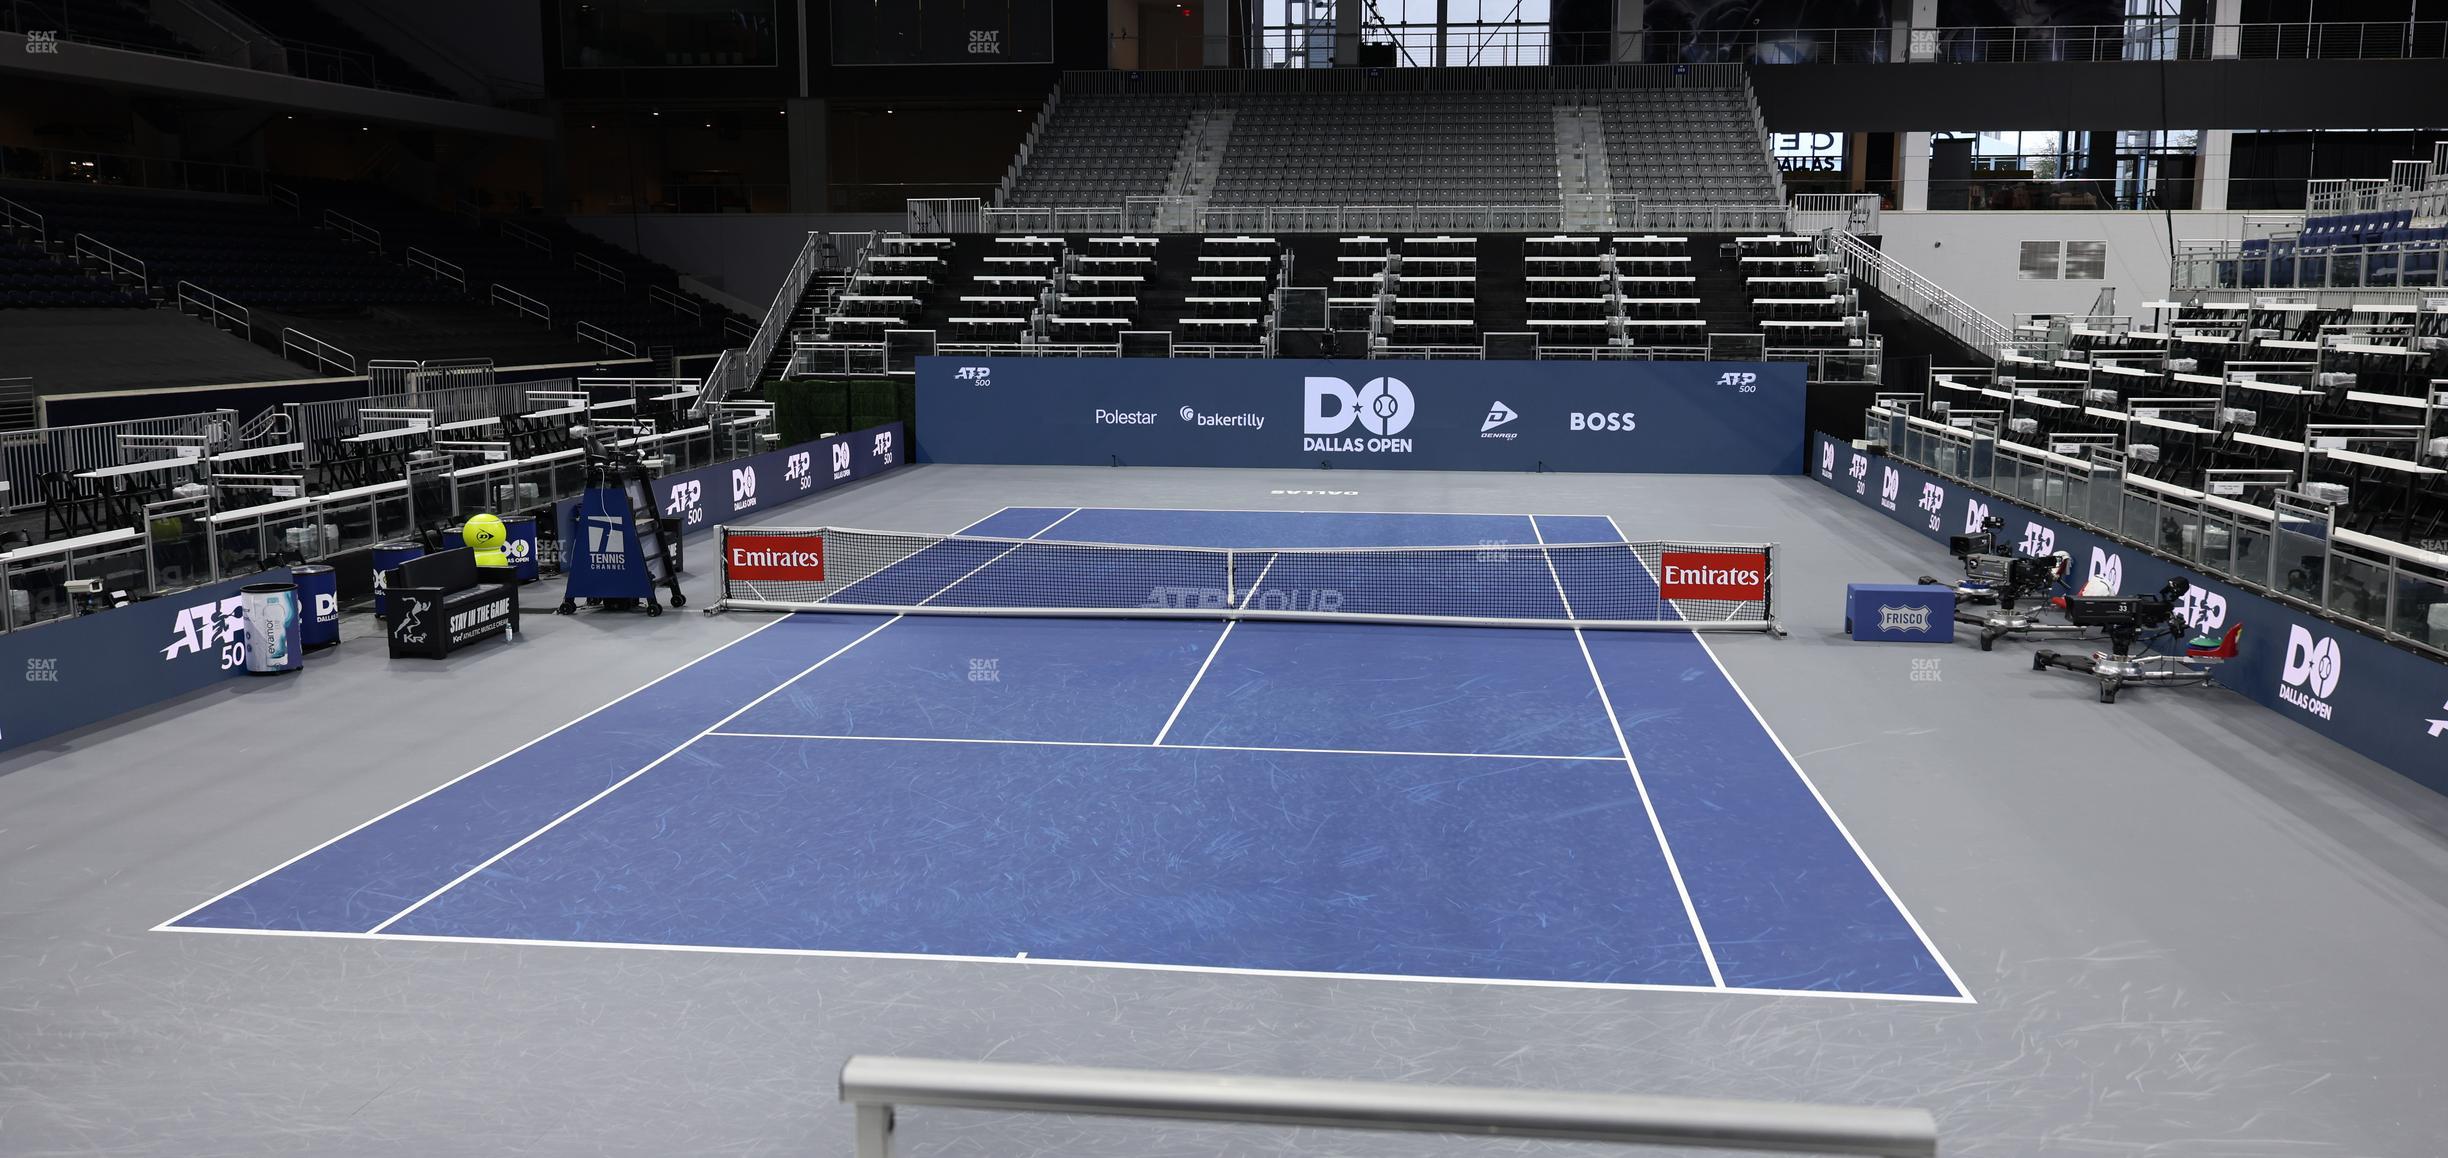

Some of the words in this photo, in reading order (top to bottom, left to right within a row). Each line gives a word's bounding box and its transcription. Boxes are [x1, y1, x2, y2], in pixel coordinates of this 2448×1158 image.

[953, 366, 990, 380] ATP
[1714, 372, 1756, 386] ATP
[1304, 376, 1415, 436] DO
[1096, 409, 1158, 424] Polestar
[1197, 413, 1264, 430] bakertilly
[1570, 412, 1636, 432] BOSS
[872, 432, 892, 456] ATP
[1304, 437, 1364, 452] DALLAS
[1368, 438, 1412, 453] OPEN
[784, 452, 810, 482] ATP
[732, 466, 756, 502] DO
[800, 476, 812, 490] 500
[666, 480, 700, 516] ATP
[1918, 482, 1944, 514] ATP
[688, 508, 702, 525] 500
[1928, 514, 1940, 532] 500
[590, 553, 625, 564] TENNIS
[732, 548, 819, 567] Emirates
[1664, 566, 1760, 586] Emirates
[450, 612, 468, 634] STAY
[468, 608, 476, 628] IN
[476, 604, 490, 624] THE
[490, 597, 510, 620] GAME
[1886, 612, 1923, 625] FRISCO
[266, 618, 276, 654] evamor
[220, 642, 246, 670] 50
[2282, 624, 2342, 699] DO
[2279, 684, 2308, 710] DALLAS
[2308, 698, 2332, 720] OPEN
